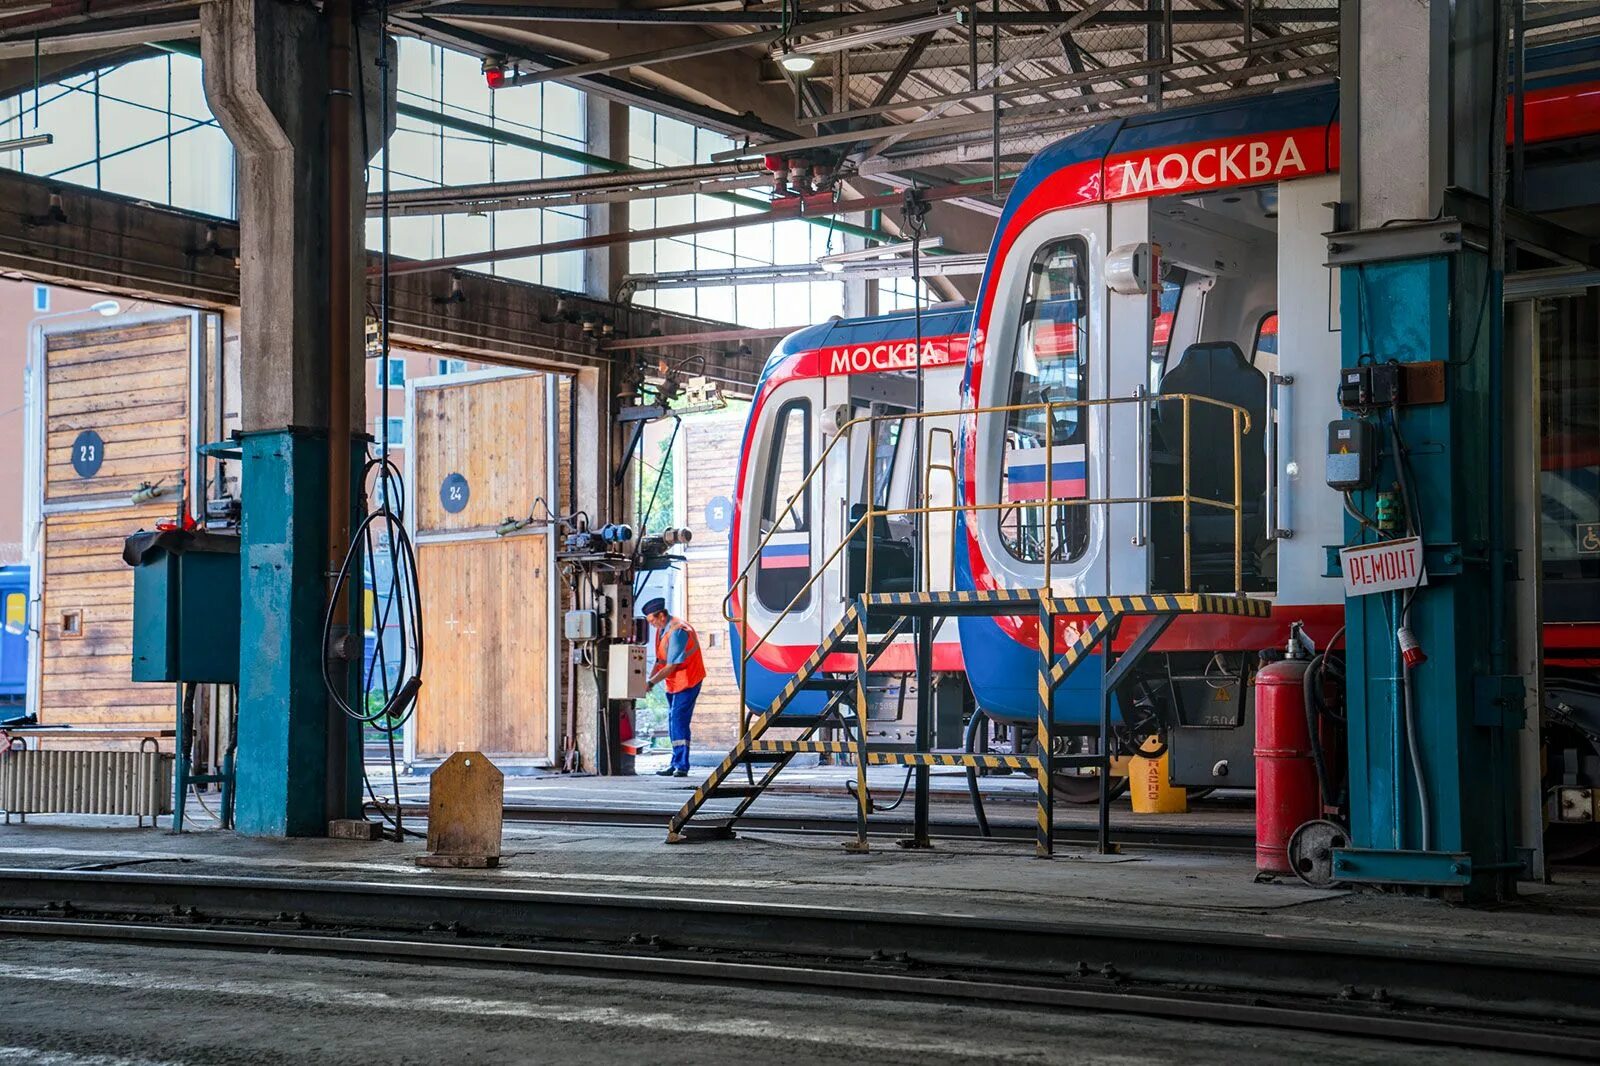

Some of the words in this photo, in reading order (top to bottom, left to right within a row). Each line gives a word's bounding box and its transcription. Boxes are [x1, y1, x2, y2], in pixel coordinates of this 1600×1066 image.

[1120, 137, 1306, 195] МОСКВА
[830, 341, 941, 373] МОСКВА
[80, 445, 95, 462] 23
[450, 486, 462, 501] 24
[1349, 548, 1415, 586] РЕМОНТ
[1148, 760, 1159, 801] ПАСНО
